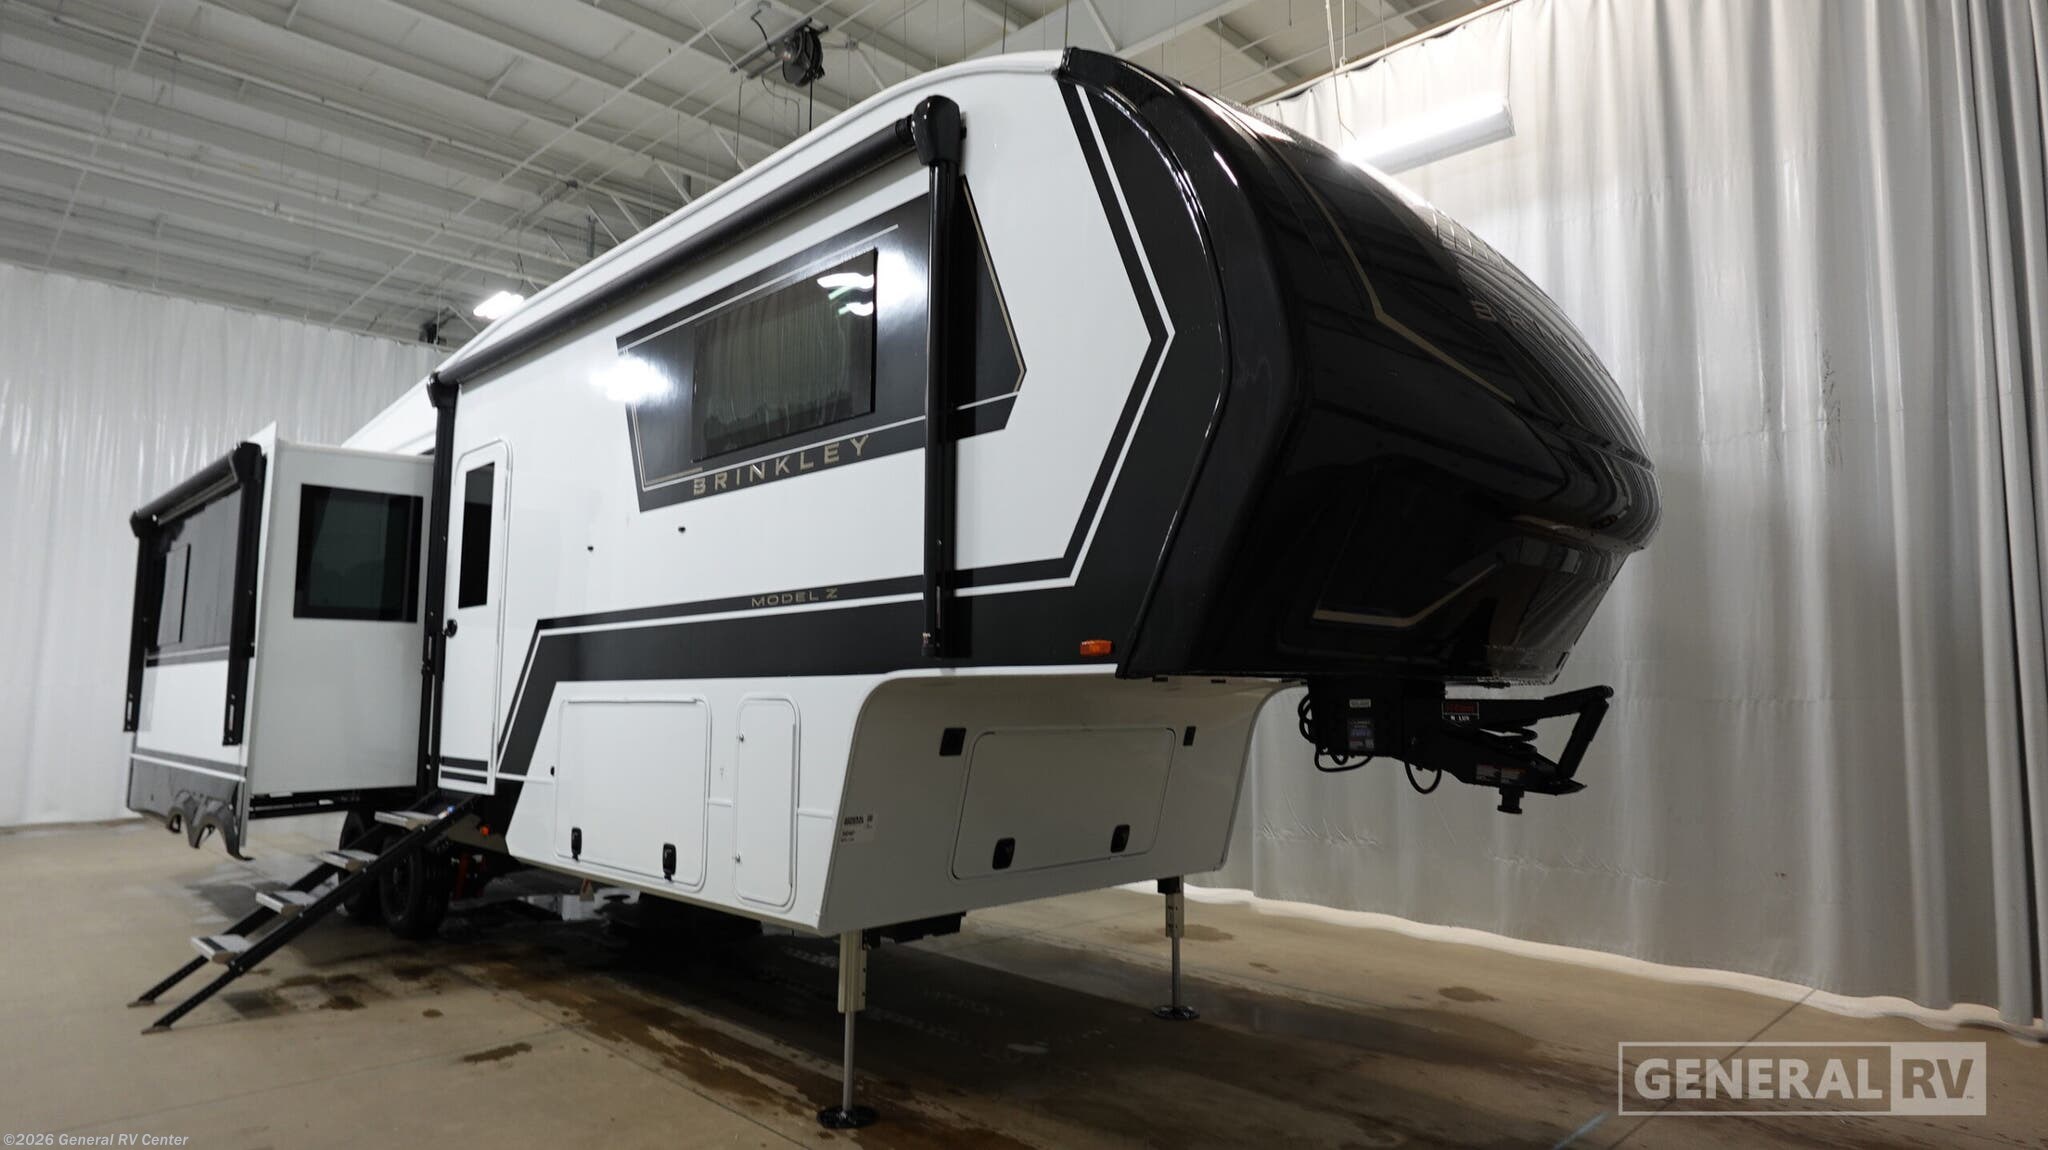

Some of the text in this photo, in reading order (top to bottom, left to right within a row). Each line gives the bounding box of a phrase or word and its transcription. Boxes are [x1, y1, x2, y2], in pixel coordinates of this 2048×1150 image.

[693, 434, 870, 496] BRINKLEY
[751, 588, 838, 607] MODEL Z
